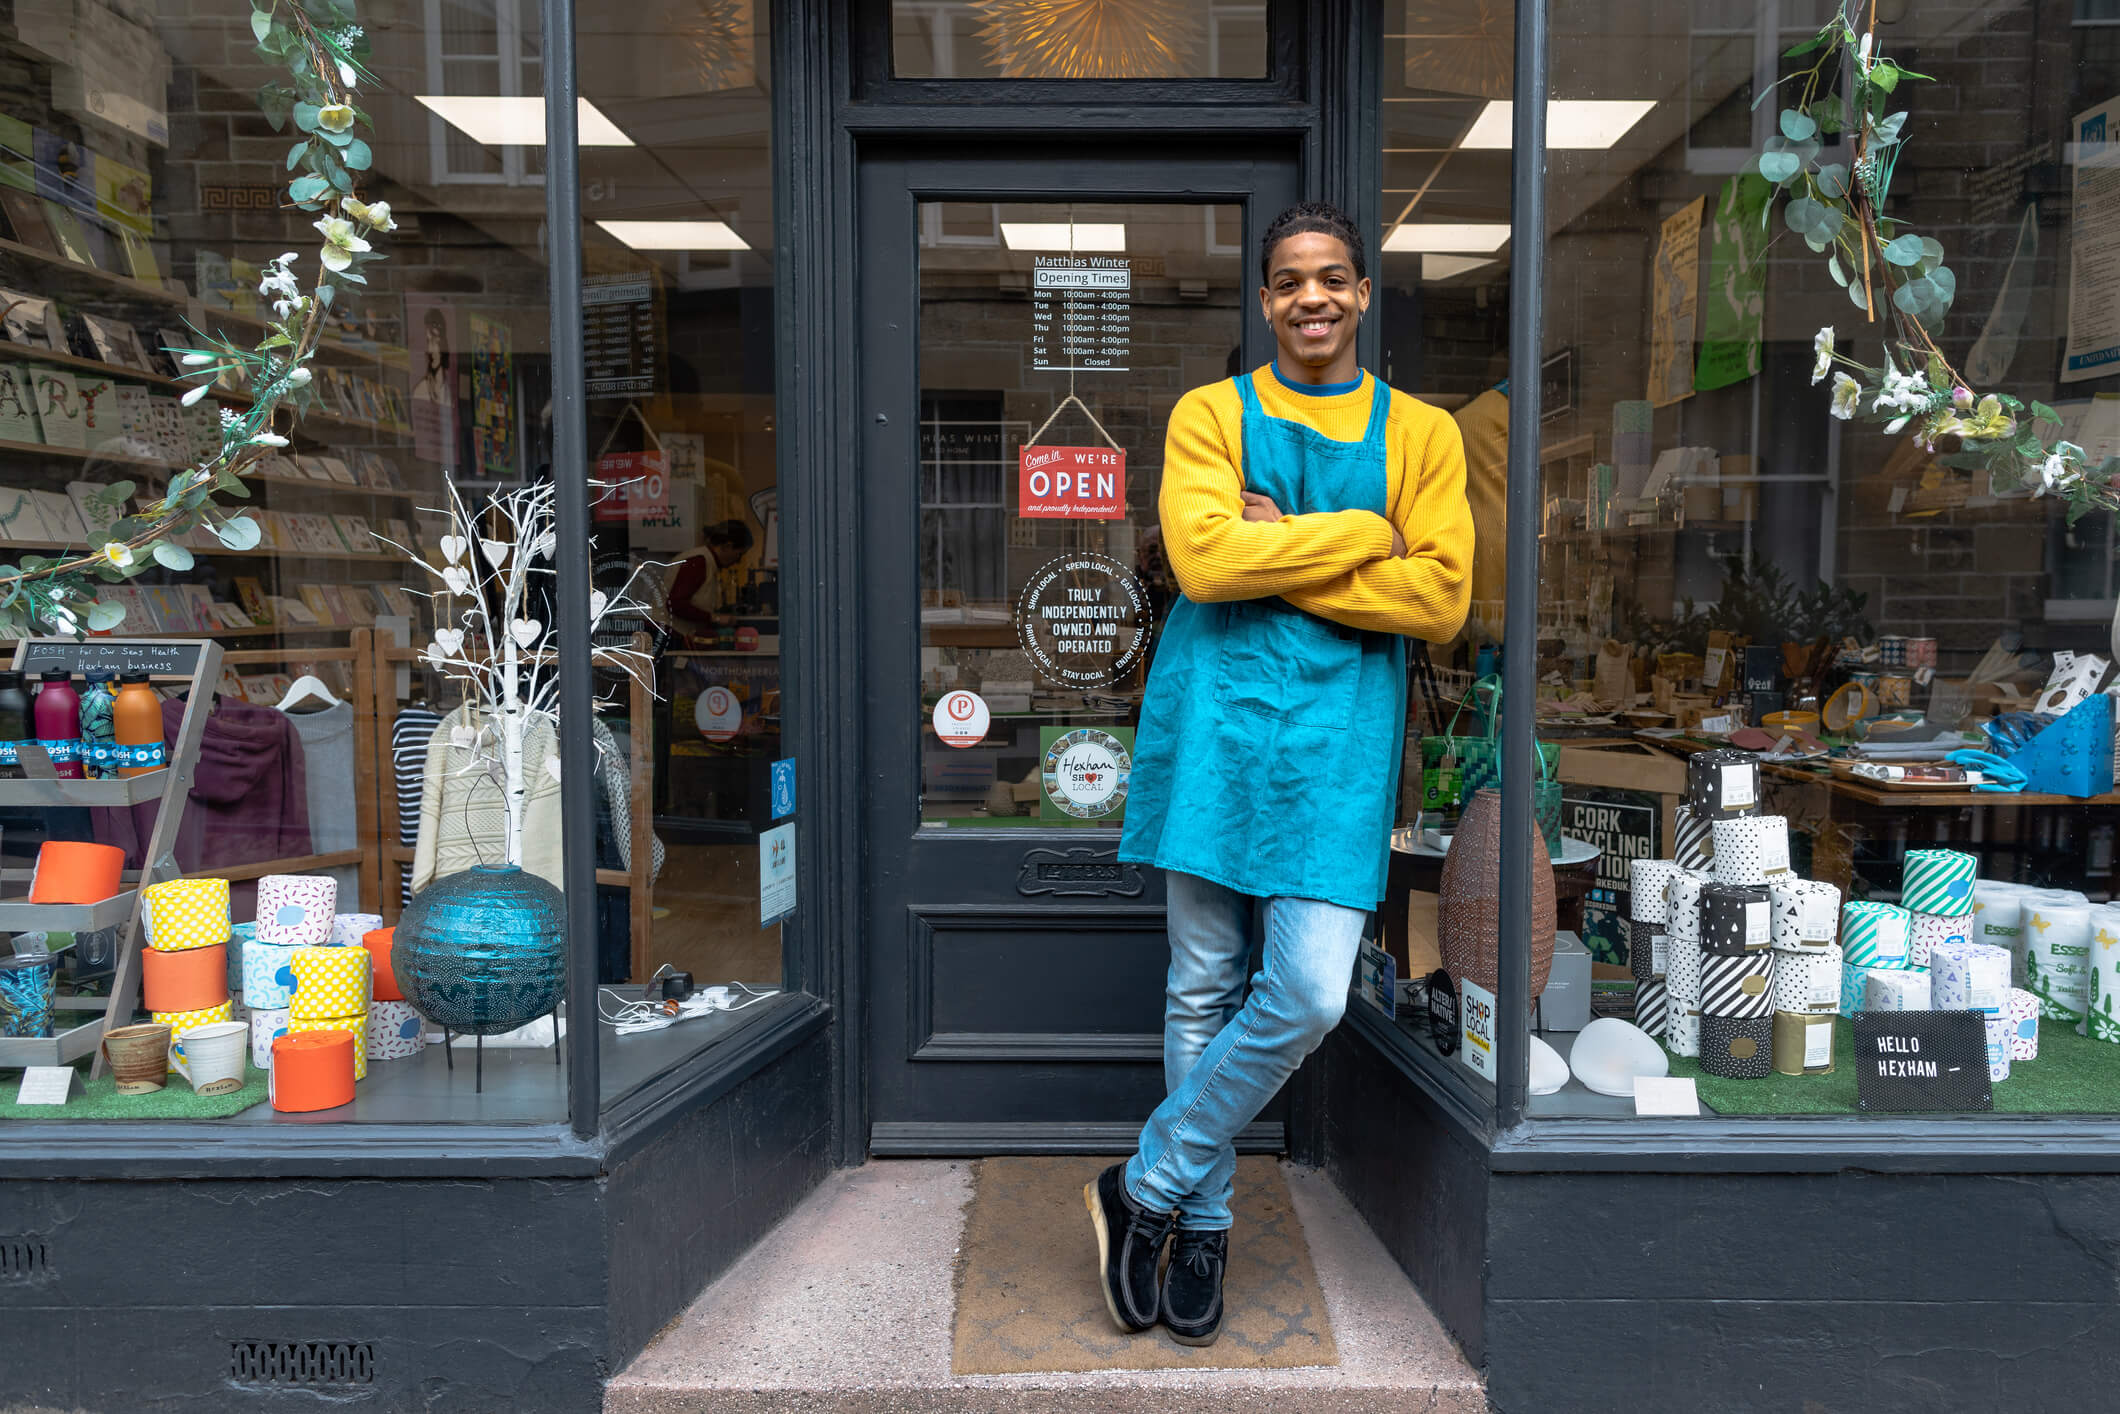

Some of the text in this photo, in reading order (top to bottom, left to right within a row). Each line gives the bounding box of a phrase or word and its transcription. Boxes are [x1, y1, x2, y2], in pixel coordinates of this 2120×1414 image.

[1035, 256, 1130, 267] Matthias Winter
[1039, 272, 1126, 285] Opening Times
[1062, 291, 1095, 299] 10:00am
[1101, 292, 1130, 300] 4:00pm
[1062, 302, 1095, 310] 10:00am
[1101, 303, 1130, 311] 4:00pm
[1101, 314, 1130, 322] 4:00pm
[1101, 326, 1130, 334] 4:00pm
[1062, 336, 1095, 344] 10:00am
[1101, 337, 1130, 345] 4:00pm
[1101, 348, 1130, 356] 4:00pm
[1084, 358, 1110, 366] Closed
[1026, 450, 1060, 467] Come in
[1075, 454, 1117, 464] WE'RE
[1030, 471, 1114, 498] OPEN
[1028, 504, 1042, 512] and
[1042, 504, 1071, 515] proudly
[1065, 561, 1113, 576] SPEND LOCAL
[1028, 571, 1058, 610] SHOP LOCAL
[1067, 588, 1102, 602] TRULY
[1120, 578, 1143, 613] EAT LOCAL
[1042, 606, 1127, 619] INDEPENDENTLY
[1053, 623, 1116, 636] OWNED AND
[32, 647, 65, 656] FOSH
[80, 647, 91, 655] For
[121, 647, 144, 656] Seas
[152, 647, 180, 656] Health
[1025, 624, 1053, 668] DRINK LOCAL
[1058, 640, 1112, 653] OPERATED
[1115, 627, 1144, 669] ENJOY LOCAL
[78, 659, 172, 670] Hexham business
[1062, 669, 1105, 680] STAY LOCAL
[957, 700, 968, 714] P
[1063, 753, 1115, 776] Hexham
[1072, 773, 1103, 784] SHOP
[1574, 806, 1621, 832] CORK
[2056, 964, 2077, 975] Soft
[1466, 995, 1490, 1022] SHOP
[1466, 1014, 1490, 1041] LOCAL
[1877, 1037, 1920, 1053] HELLO
[1878, 1060, 1937, 1077] HEXHAM
